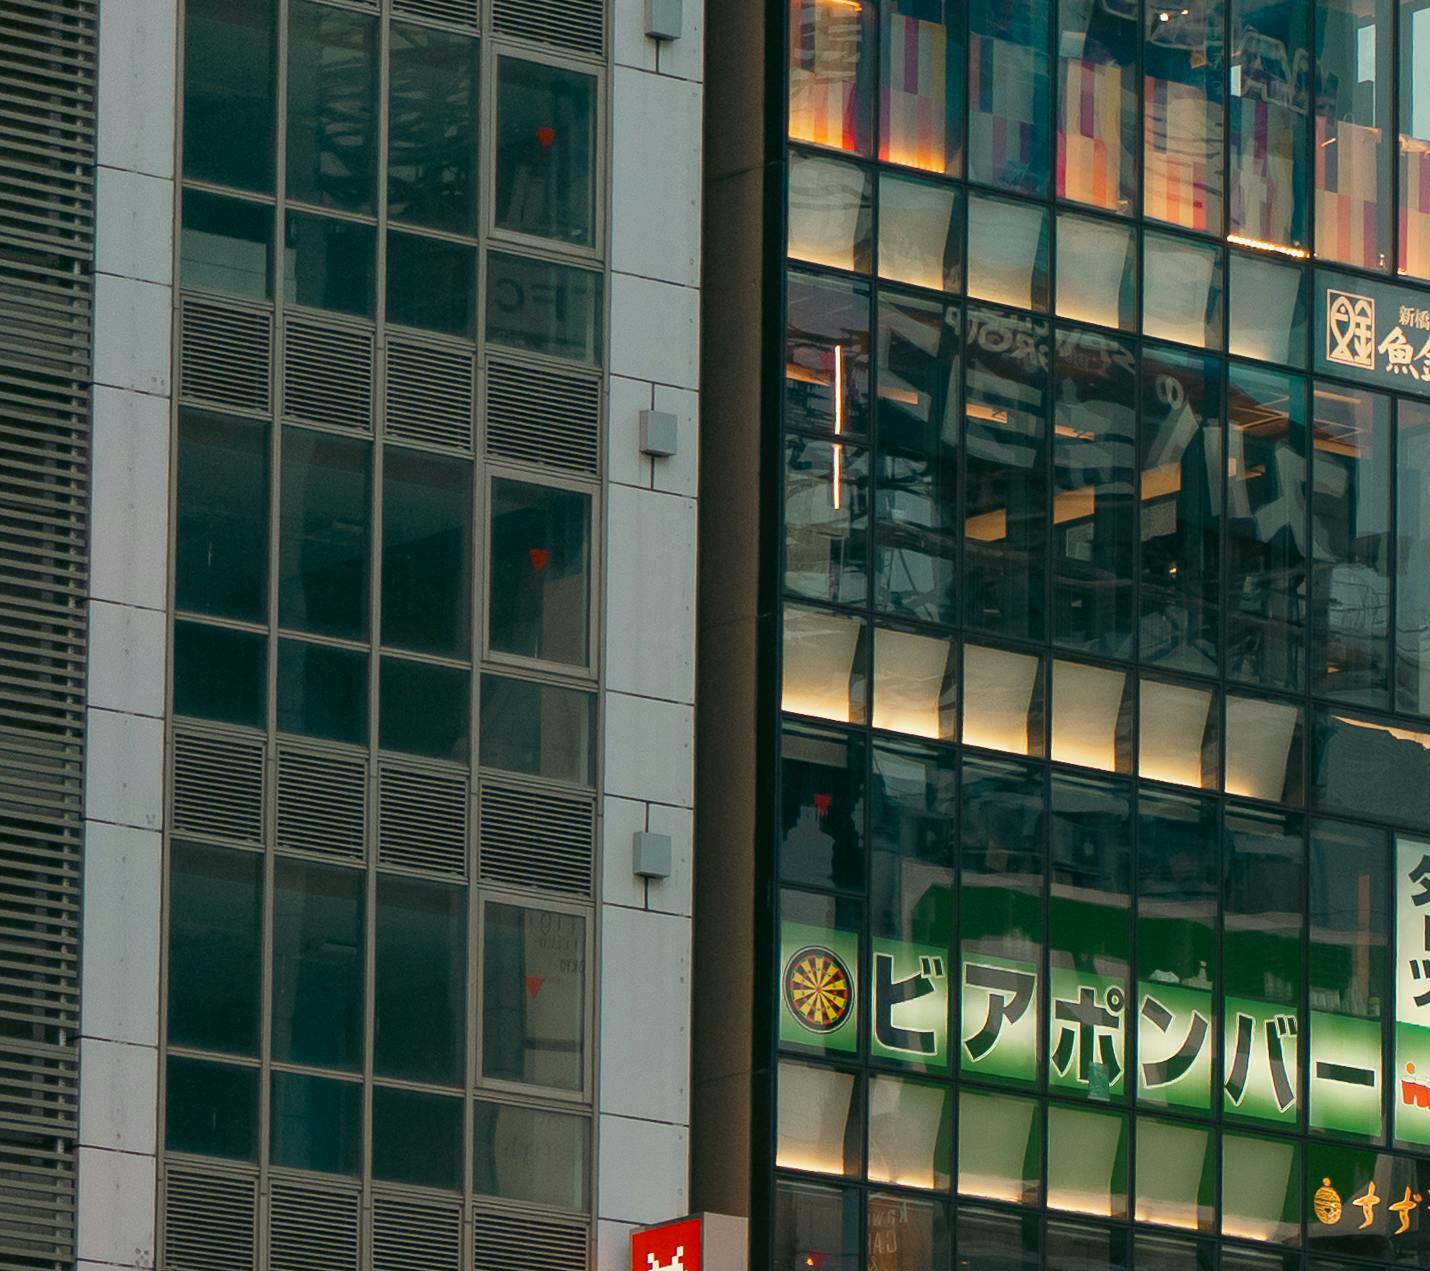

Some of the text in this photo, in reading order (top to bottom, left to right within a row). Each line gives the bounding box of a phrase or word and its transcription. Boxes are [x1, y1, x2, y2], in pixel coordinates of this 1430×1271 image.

[1399, 305, 1430, 331] 新橋
[873, 953, 1376, 1113] ビアポンバー
